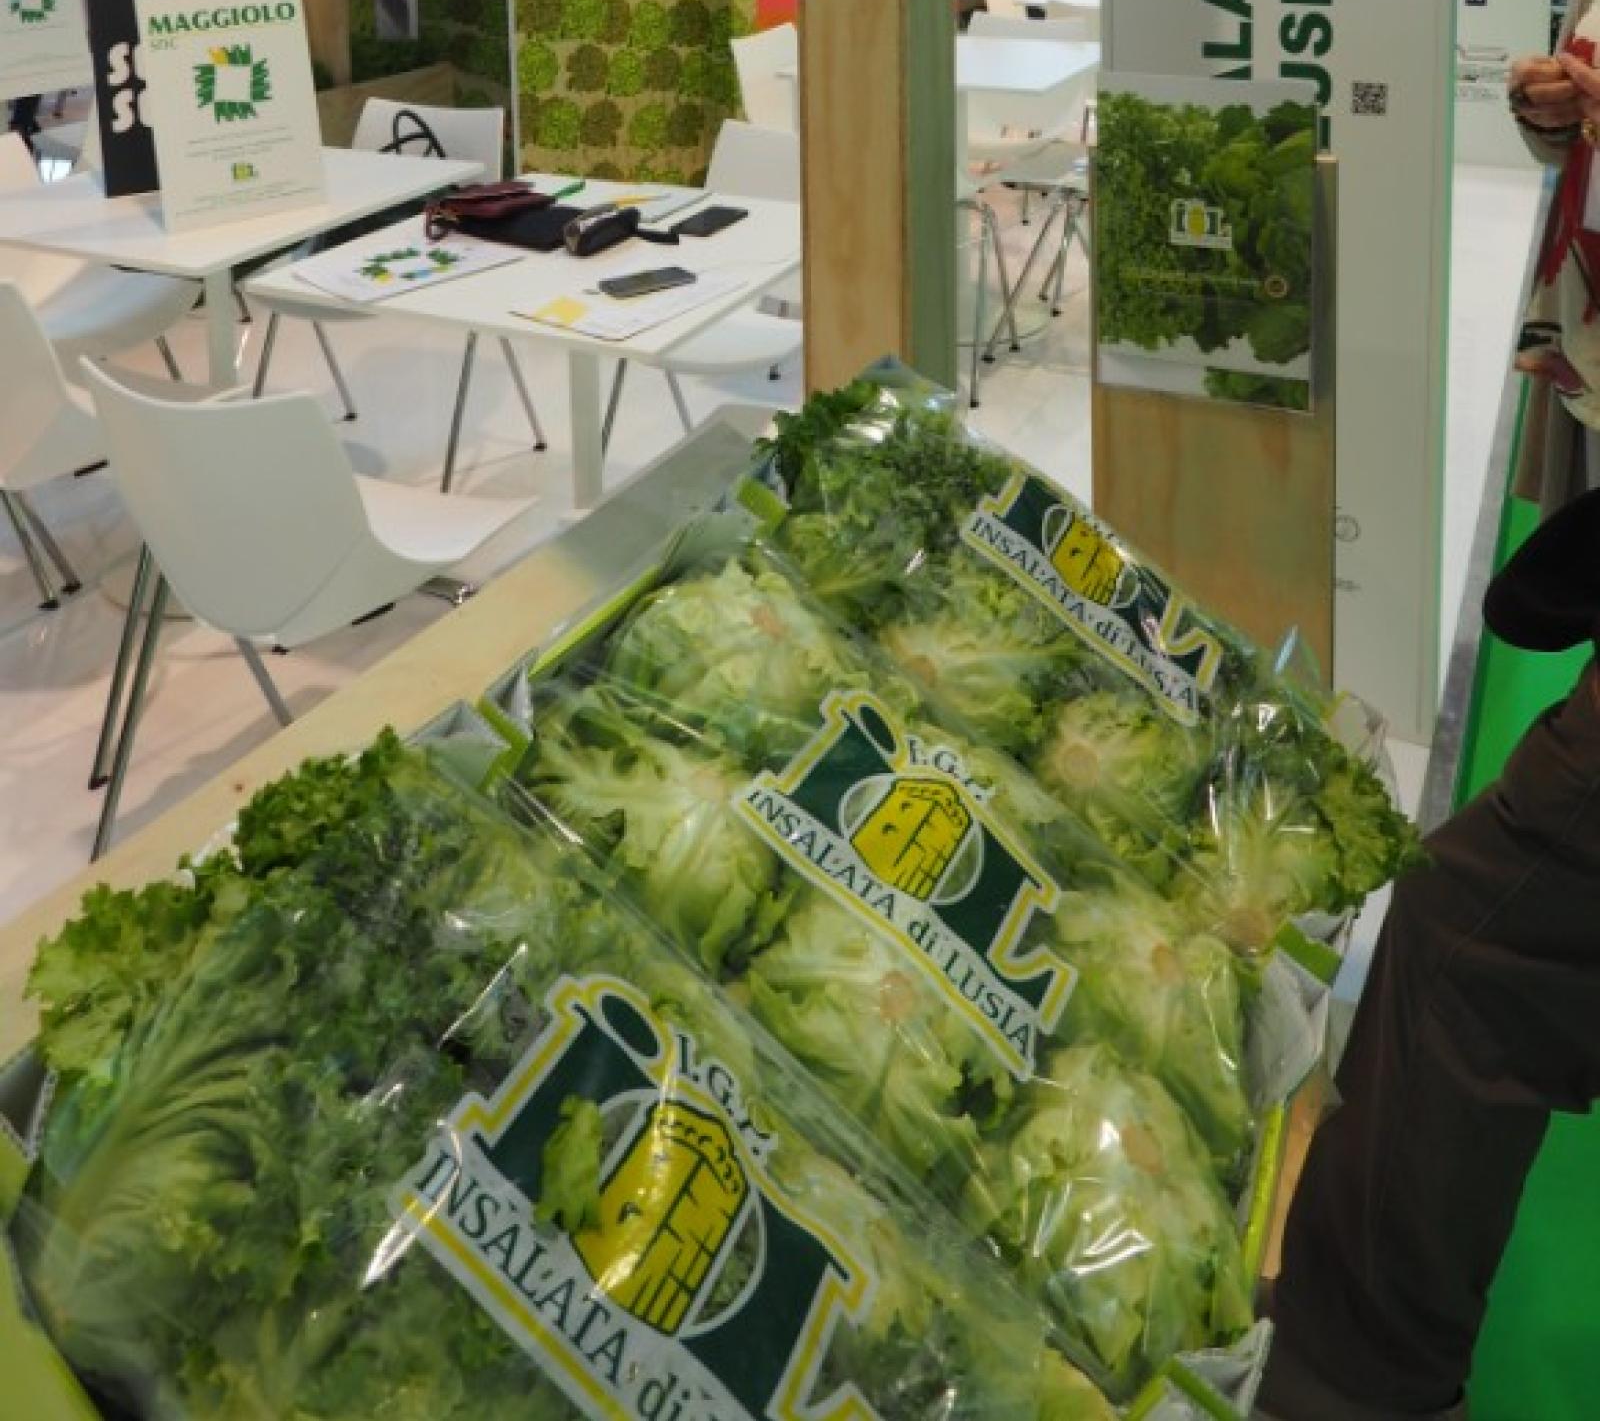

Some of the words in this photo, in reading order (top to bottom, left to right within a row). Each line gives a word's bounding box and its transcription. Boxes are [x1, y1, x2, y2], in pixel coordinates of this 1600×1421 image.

[148, 2, 295, 34] MAGGIOLO
[746, 788, 898, 920] INSALATA
[908, 921, 936, 956] di
[941, 950, 1034, 1057] LUSIA
[415, 1151, 628, 1387] INSALATA
